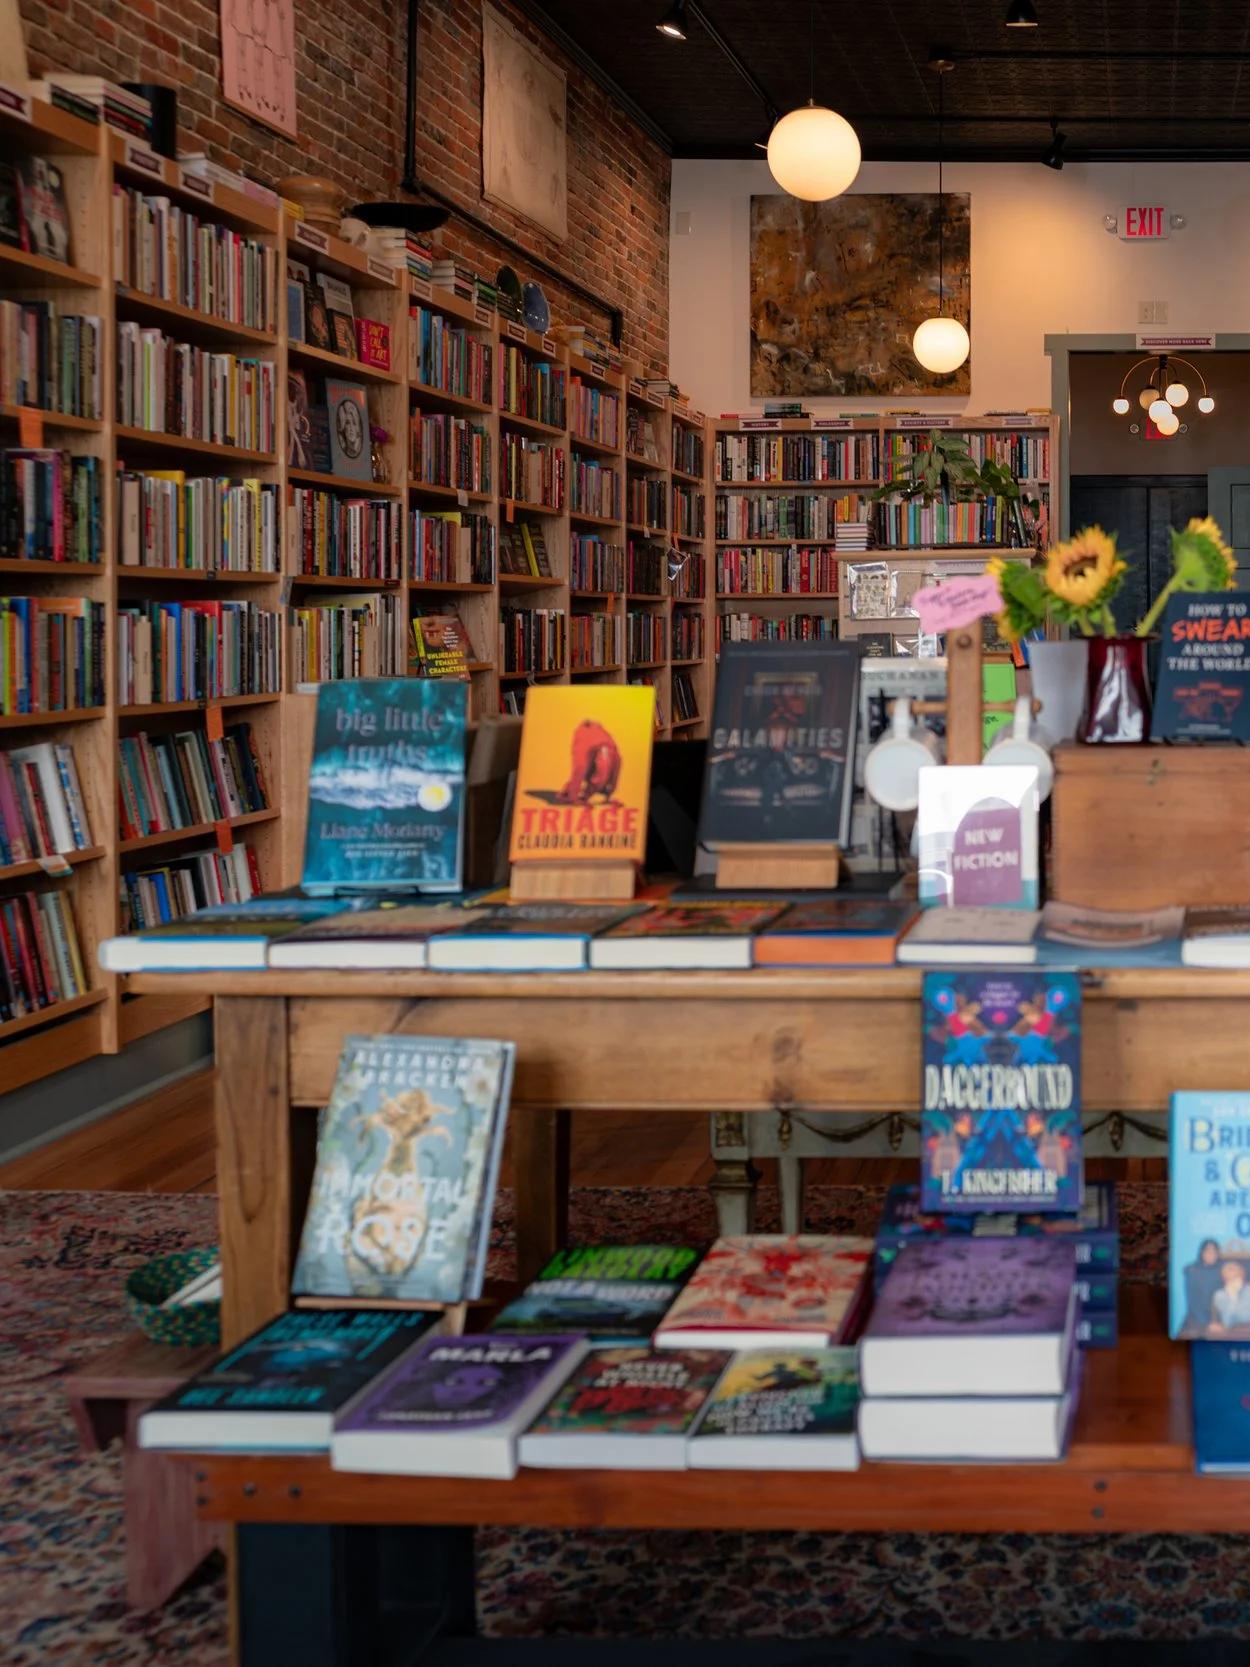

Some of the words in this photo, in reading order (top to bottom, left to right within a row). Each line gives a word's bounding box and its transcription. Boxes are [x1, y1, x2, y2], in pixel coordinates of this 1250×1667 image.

[1126, 207, 1164, 236] EXIT
[376, 348, 388, 361] ART
[1187, 602, 1225, 615] HOW
[1228, 602, 1247, 615] TO
[1180, 643, 1245, 657] AROUND
[428, 665, 469, 675] CHARACTERS
[434, 658, 459, 667] FEMALE
[1167, 657, 1198, 671] THE
[335, 706, 376, 738] big
[384, 705, 444, 732] little
[713, 727, 844, 750] CALAMITIES
[347, 739, 429, 764] truths
[320, 821, 369, 842] Liane
[373, 821, 446, 843] Moriarty
[520, 807, 639, 835] TRIAGE
[517, 833, 575, 850] CLAUDIA
[579, 834, 638, 850] RANKINE
[964, 827, 1004, 847] NEW
[954, 850, 1019, 872] FICTION
[353, 1049, 487, 1071] ALEXANDRA
[924, 1063, 1074, 1111] DAGGERBOUND
[942, 1168, 959, 1195] T.
[962, 1167, 1059, 1195] KINGFISHER
[1204, 1158, 1221, 1183] &
[318, 1171, 467, 1203] IMMORTAL
[1208, 1189, 1250, 1209] ARE
[314, 1213, 448, 1262] ROSE
[428, 1346, 553, 1363] MARLA
